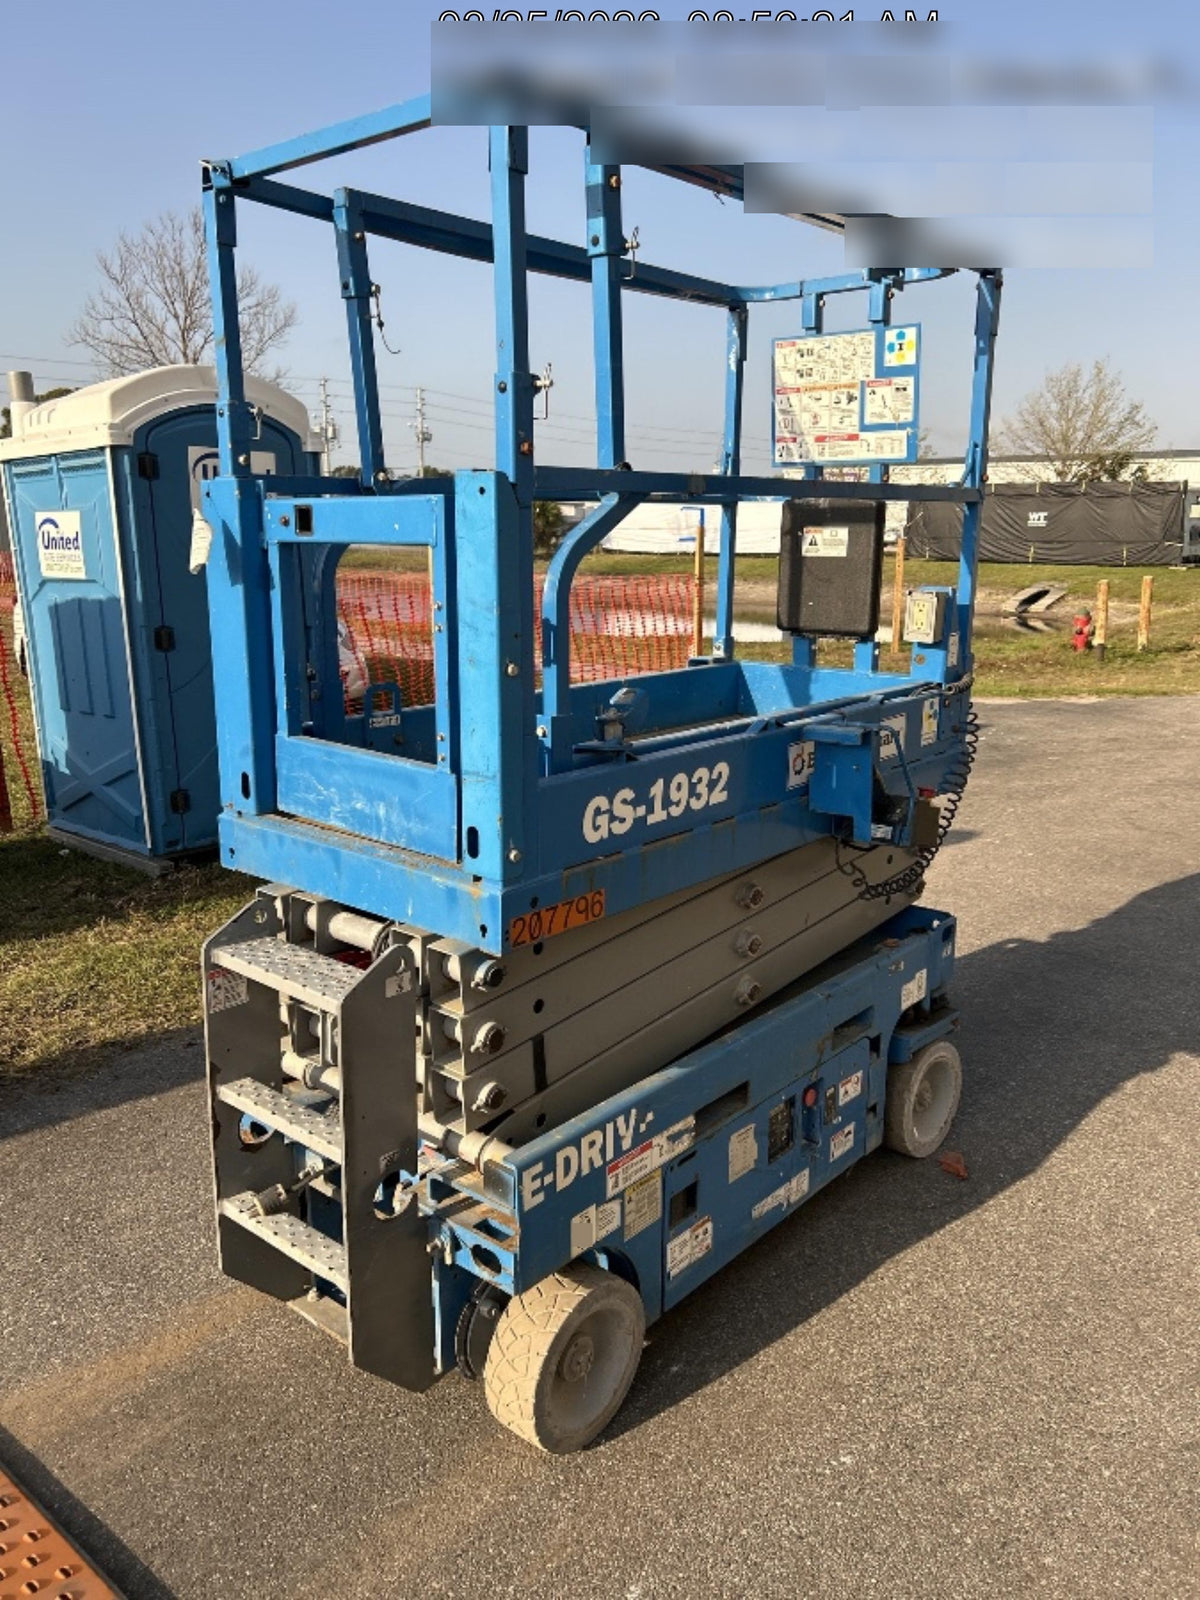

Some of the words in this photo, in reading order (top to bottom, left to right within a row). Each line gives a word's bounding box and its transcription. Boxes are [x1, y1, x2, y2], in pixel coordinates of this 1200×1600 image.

[42, 530, 80, 550] United
[582, 761, 730, 844] GS-1932
[511, 889, 604, 948] 207796
[521, 1108, 655, 1212] E-DRIV
